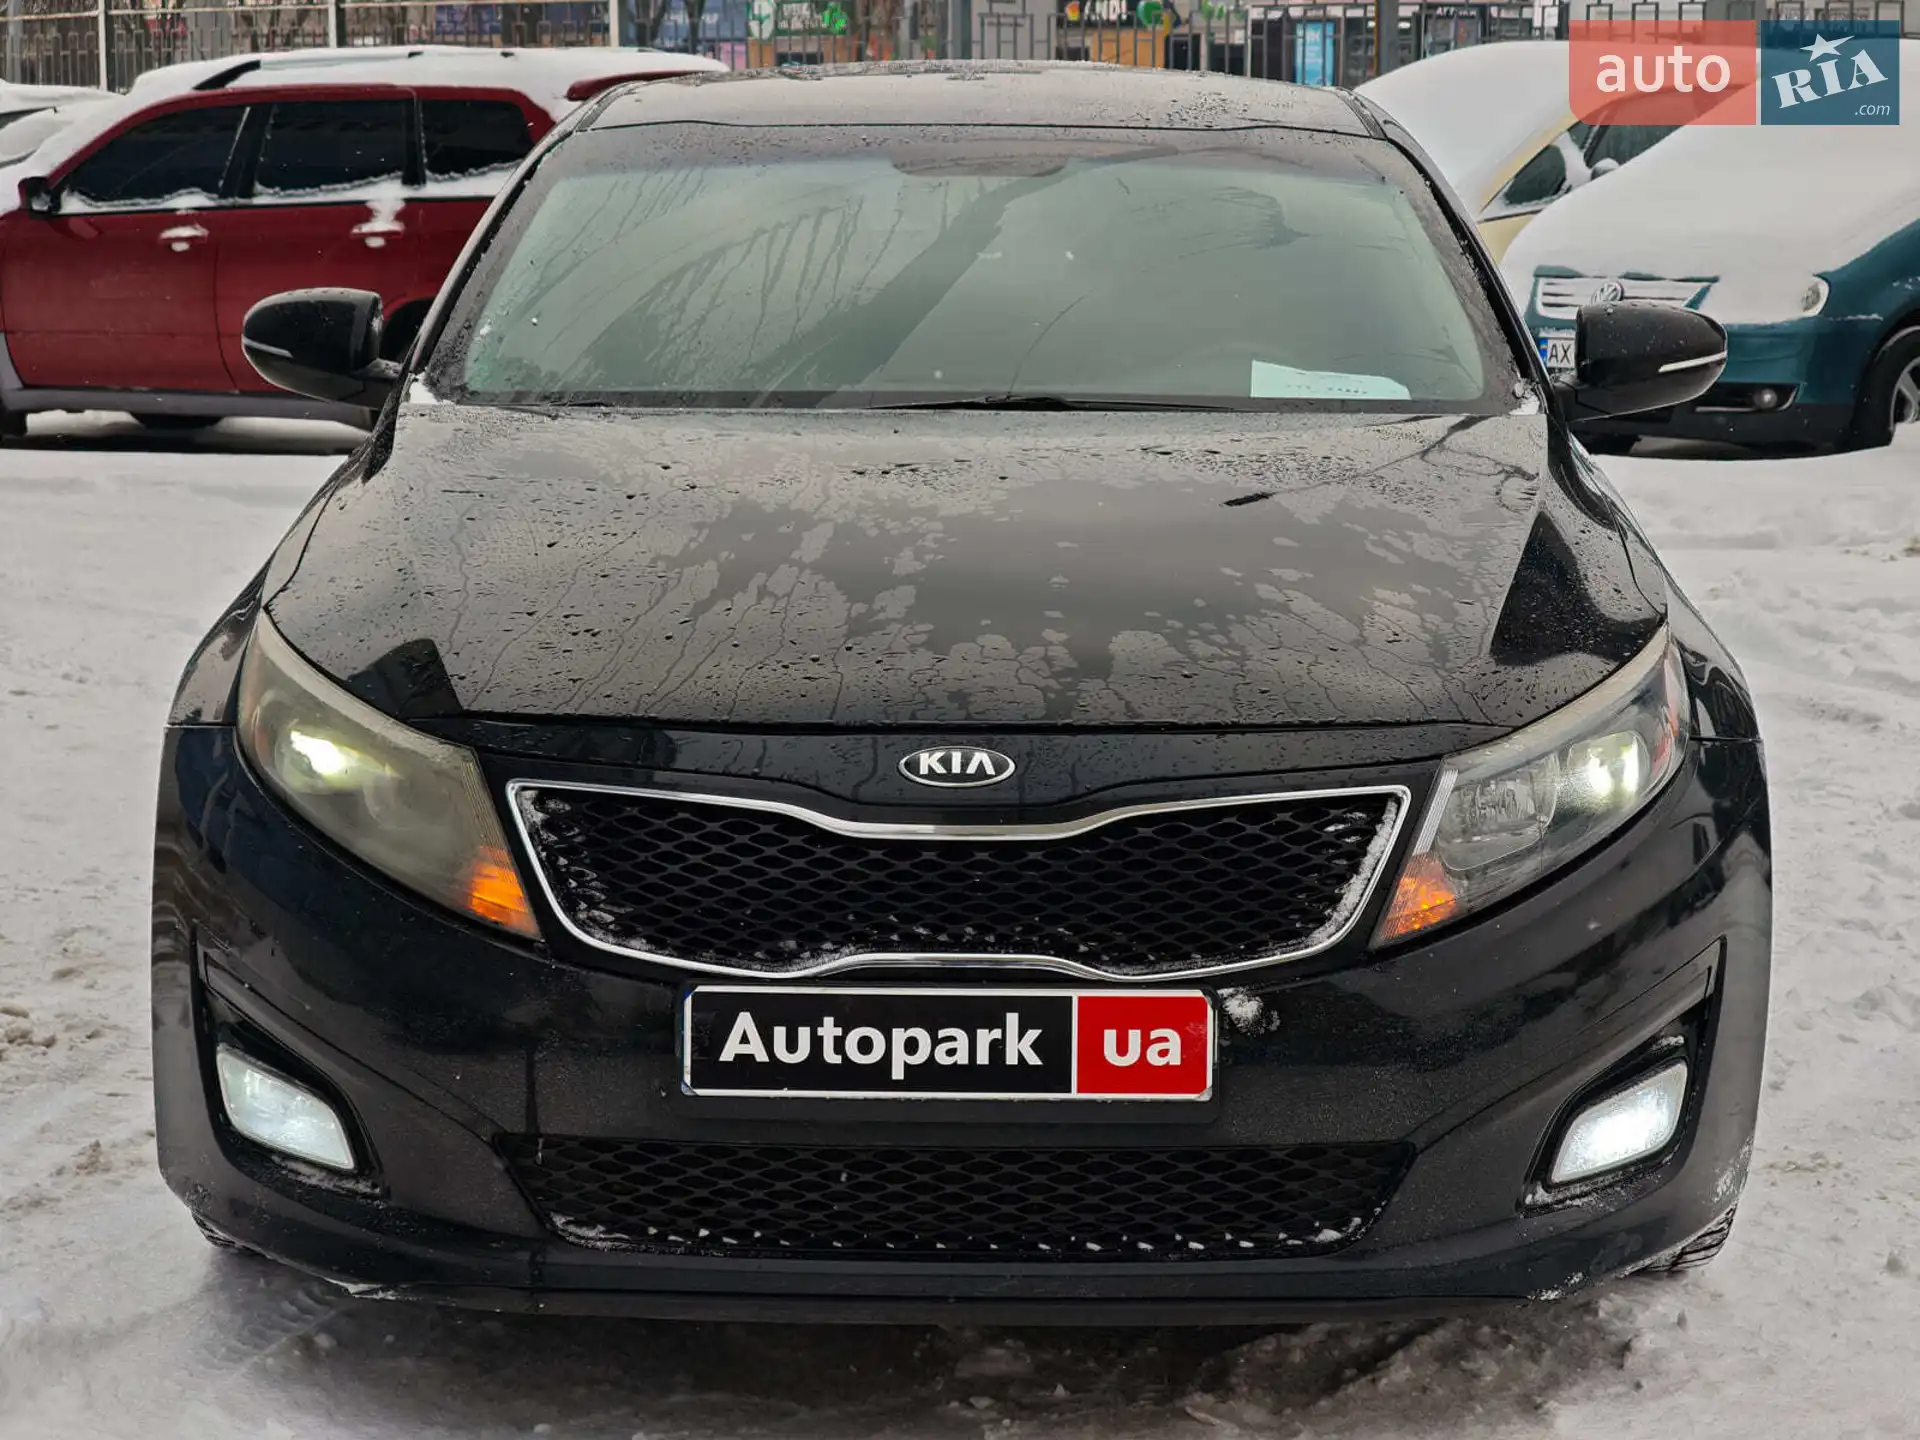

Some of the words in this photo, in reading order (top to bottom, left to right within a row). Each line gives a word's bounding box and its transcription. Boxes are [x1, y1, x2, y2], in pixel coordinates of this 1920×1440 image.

[1548, 343, 1572, 364] AX
[919, 751, 996, 775] KIA
[719, 1011, 1043, 1080] Autopark
[1102, 1027, 1182, 1067] ua
